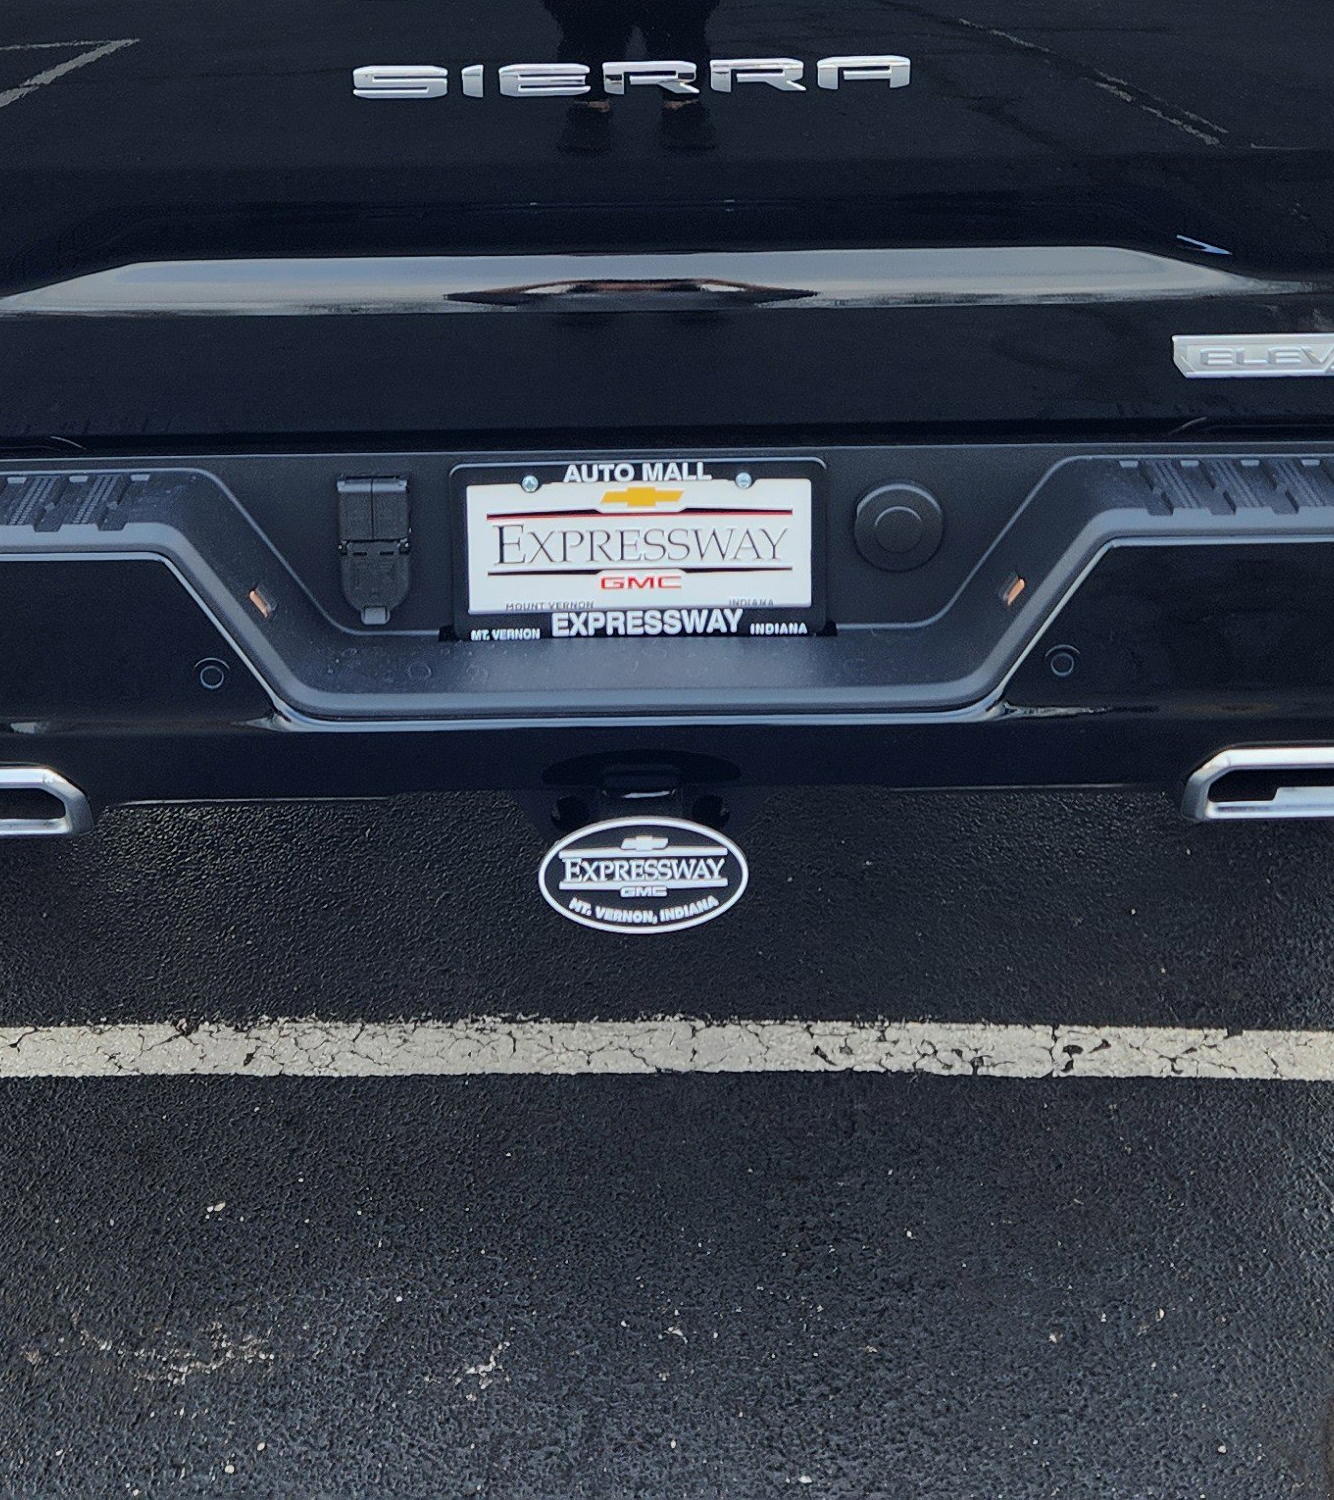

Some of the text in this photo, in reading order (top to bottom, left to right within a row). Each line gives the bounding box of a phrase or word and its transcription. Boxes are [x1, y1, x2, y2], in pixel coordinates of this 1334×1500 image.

[352, 55, 911, 99] SIERRA
[563, 461, 713, 483] AUTO MALL
[492, 523, 789, 566] EXPRESSWAY
[600, 575, 683, 590] GMC
[505, 600, 595, 612] MOUNT VERNON
[728, 598, 774, 607] INDIANA
[470, 608, 808, 641] MT. VERNON EXPRESSWAY INDIANA
[562, 857, 726, 883] EXPRESSWAY
[619, 885, 668, 898] GMC
[568, 895, 720, 925] MT. VERNON, INDIANA
